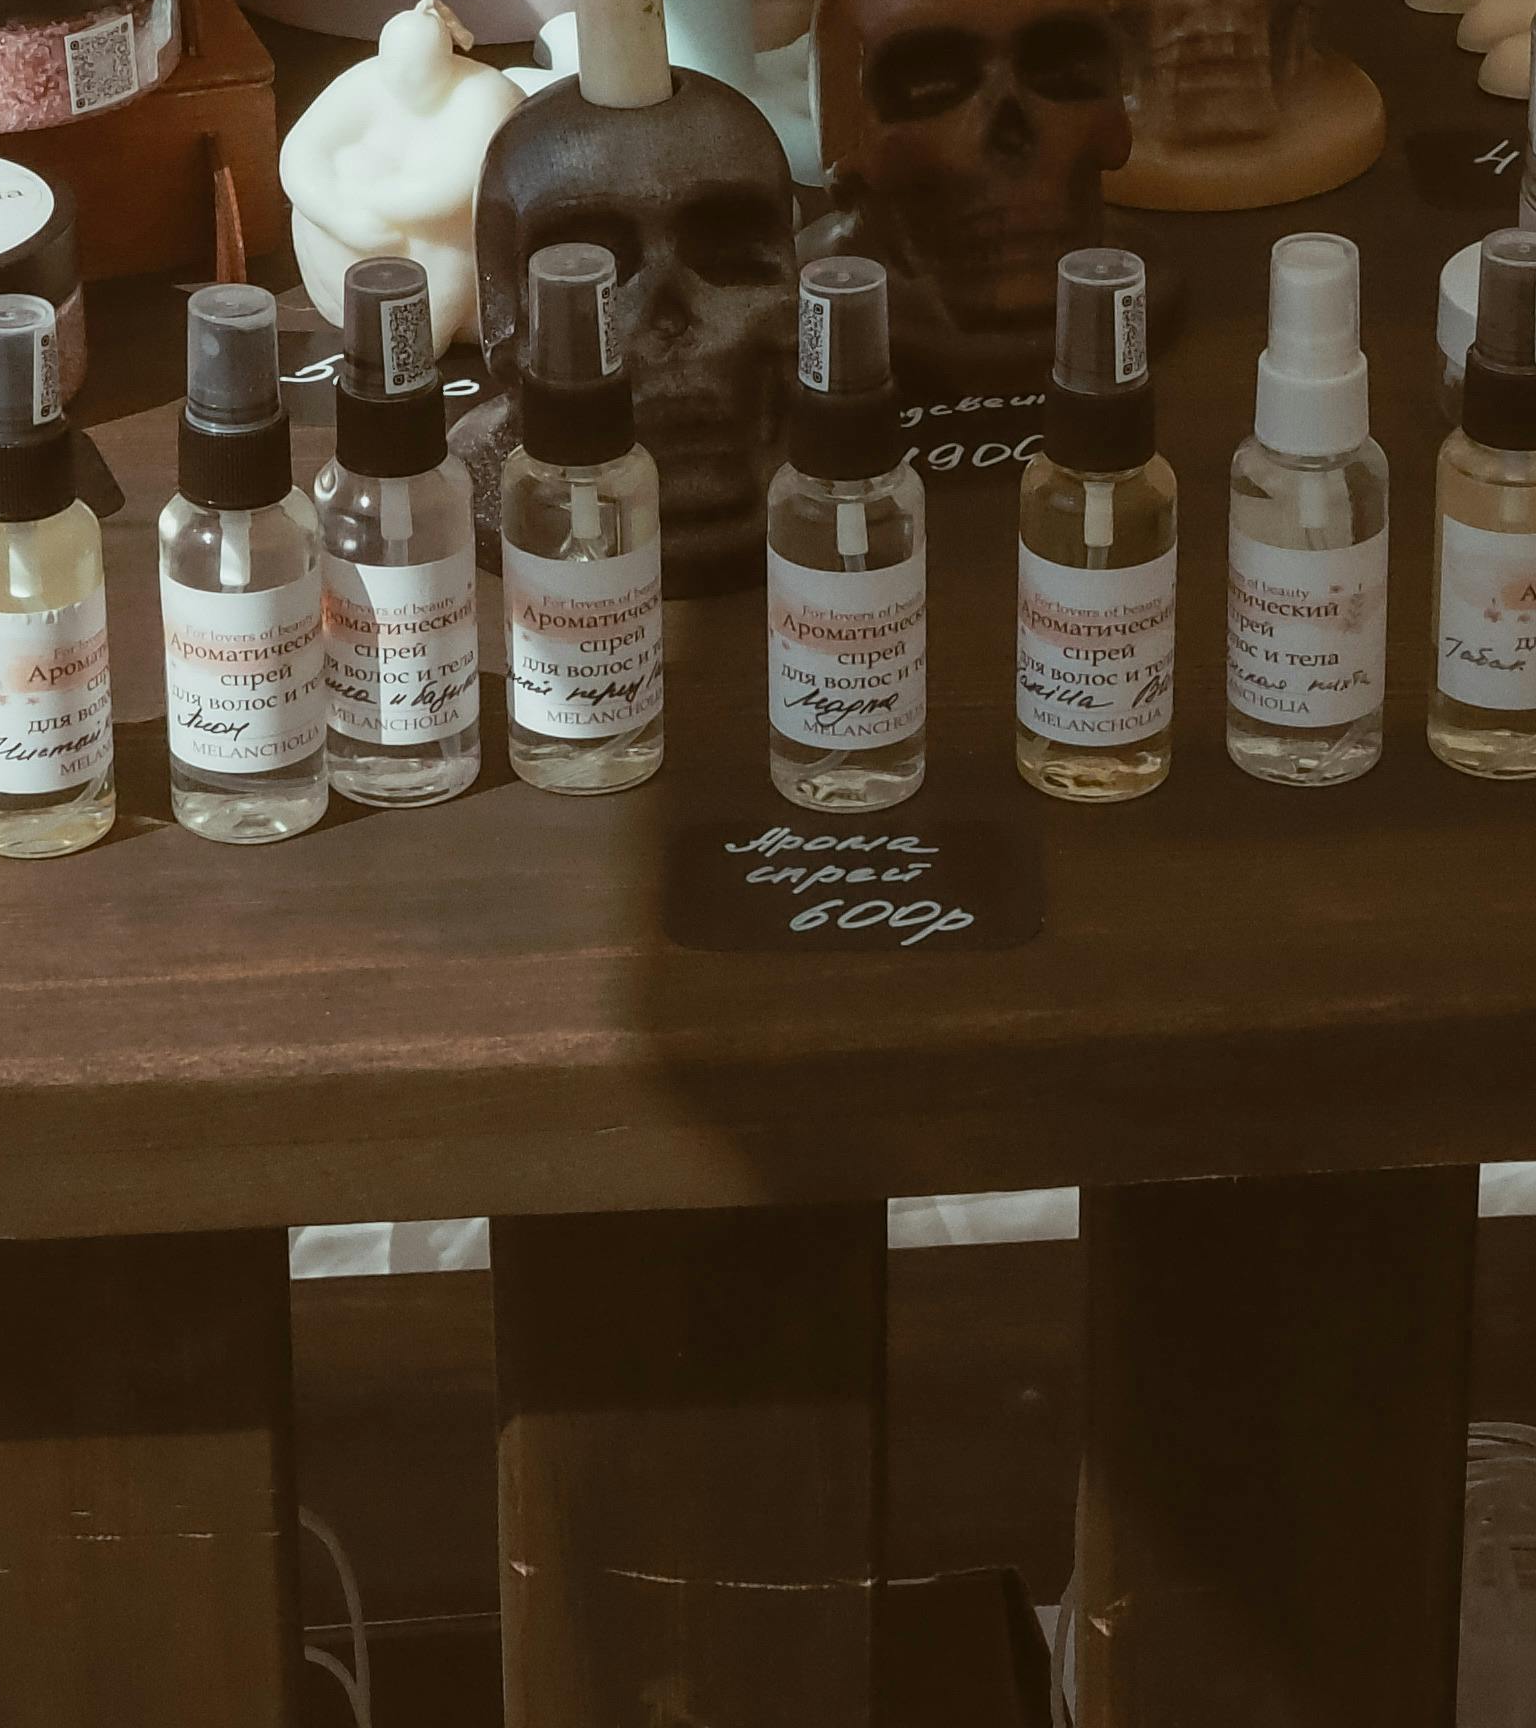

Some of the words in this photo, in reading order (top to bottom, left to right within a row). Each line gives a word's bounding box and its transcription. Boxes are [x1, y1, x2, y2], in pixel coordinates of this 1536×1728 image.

[569, 595, 614, 609] lovers
[1054, 603, 1100, 619] lovers
[210, 628, 255, 642] lovers
[260, 627, 277, 642] of
[580, 624, 646, 656] спрей
[354, 643, 427, 666] спрей
[837, 641, 907, 669] спрей
[1063, 642, 1135, 663] спрей
[1285, 651, 1340, 667] тела
[220, 663, 293, 691] спрей
[344, 665, 409, 685] волос
[417, 670, 431, 683] и
[522, 656, 560, 678] для
[567, 659, 633, 678] волос
[781, 663, 816, 687] для
[824, 672, 892, 692] волос
[1051, 668, 1117, 687] волос
[209, 695, 278, 711] волос
[285, 689, 297, 704] и
[28, 714, 72, 736] для
[1032, 707, 1163, 734] MELANCHOLIA
[724, 826, 940, 858] Арома
[745, 863, 933, 896] спрей
[789, 898, 975, 947] 600р
